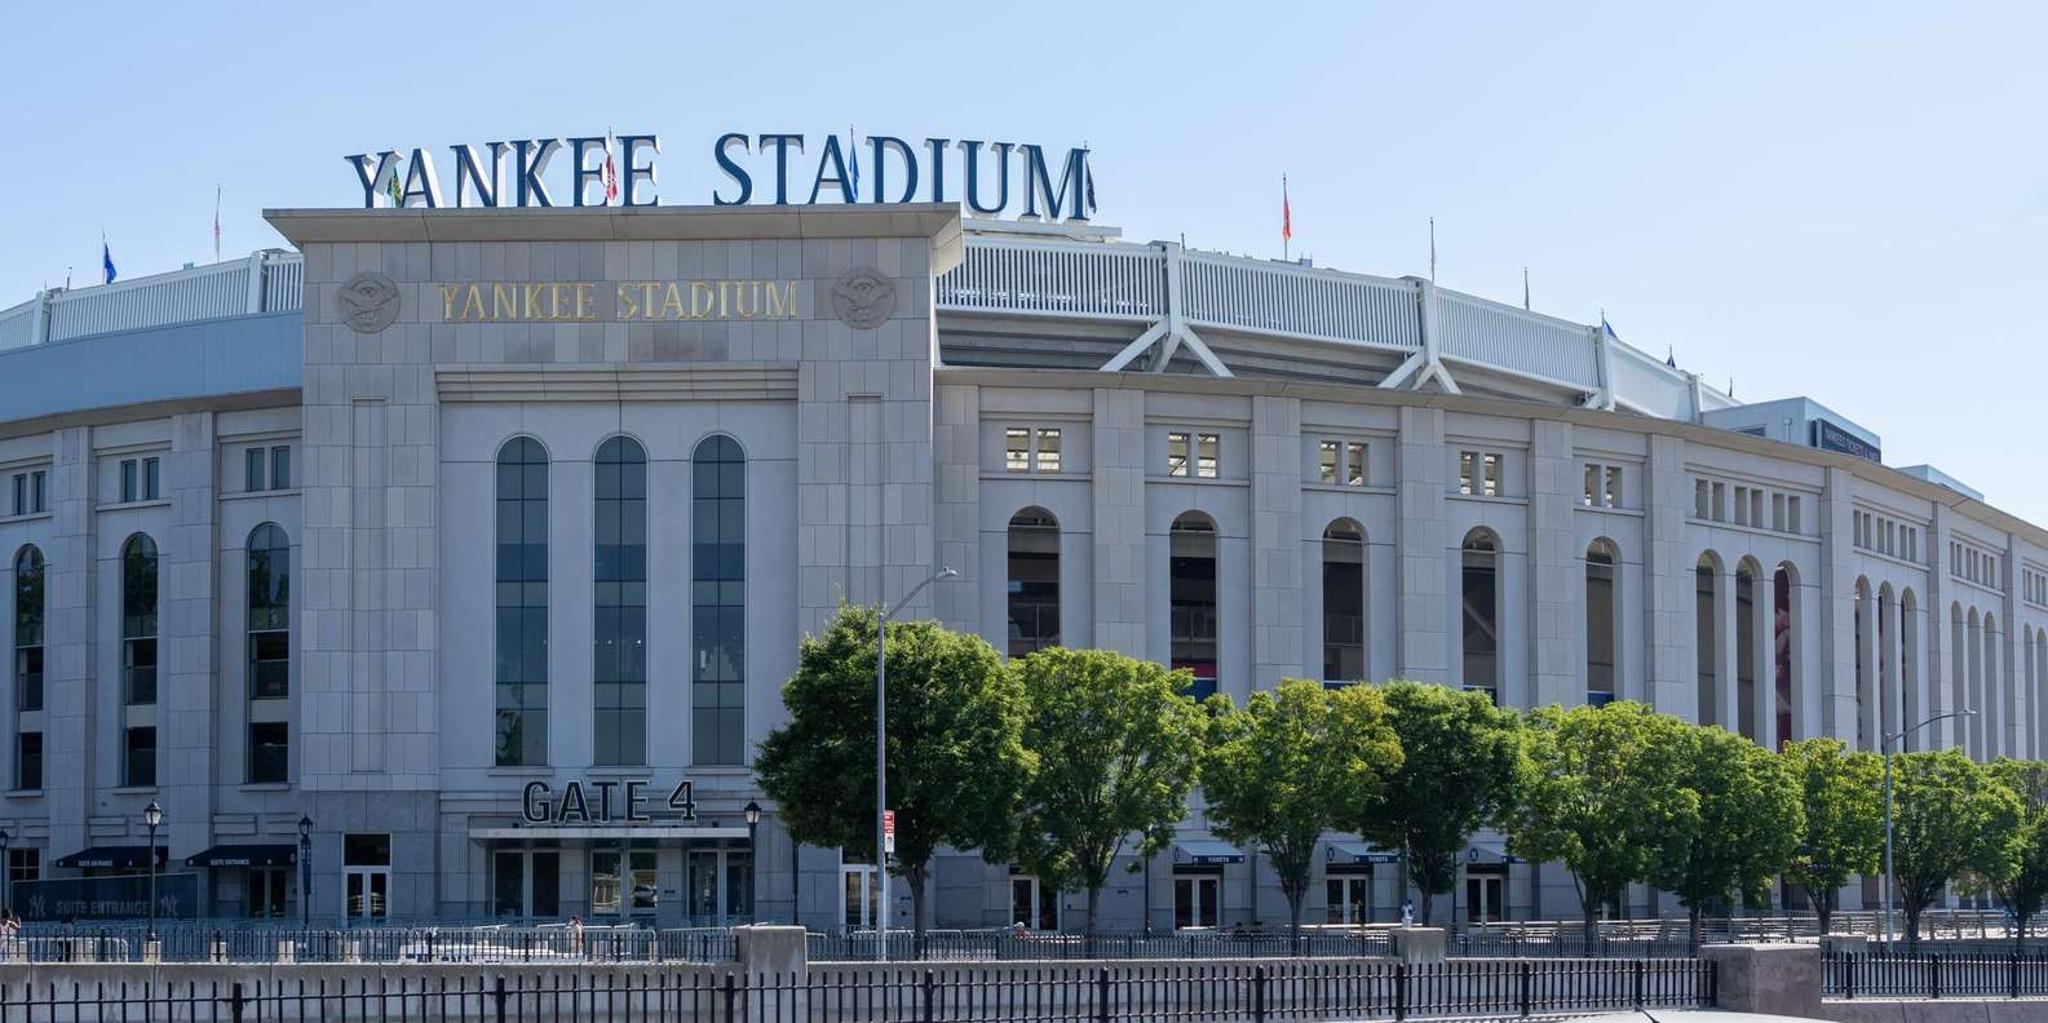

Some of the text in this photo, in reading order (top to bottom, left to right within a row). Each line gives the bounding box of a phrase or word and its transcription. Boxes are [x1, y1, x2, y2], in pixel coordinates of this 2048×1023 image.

[344, 132, 1091, 221] YANKEE STADIUM
[438, 279, 799, 321] YANKEE STADIUM
[522, 779, 697, 825] GATE 4
[56, 901, 88, 915] SUITE
[90, 901, 150, 915] ENTRANCE
